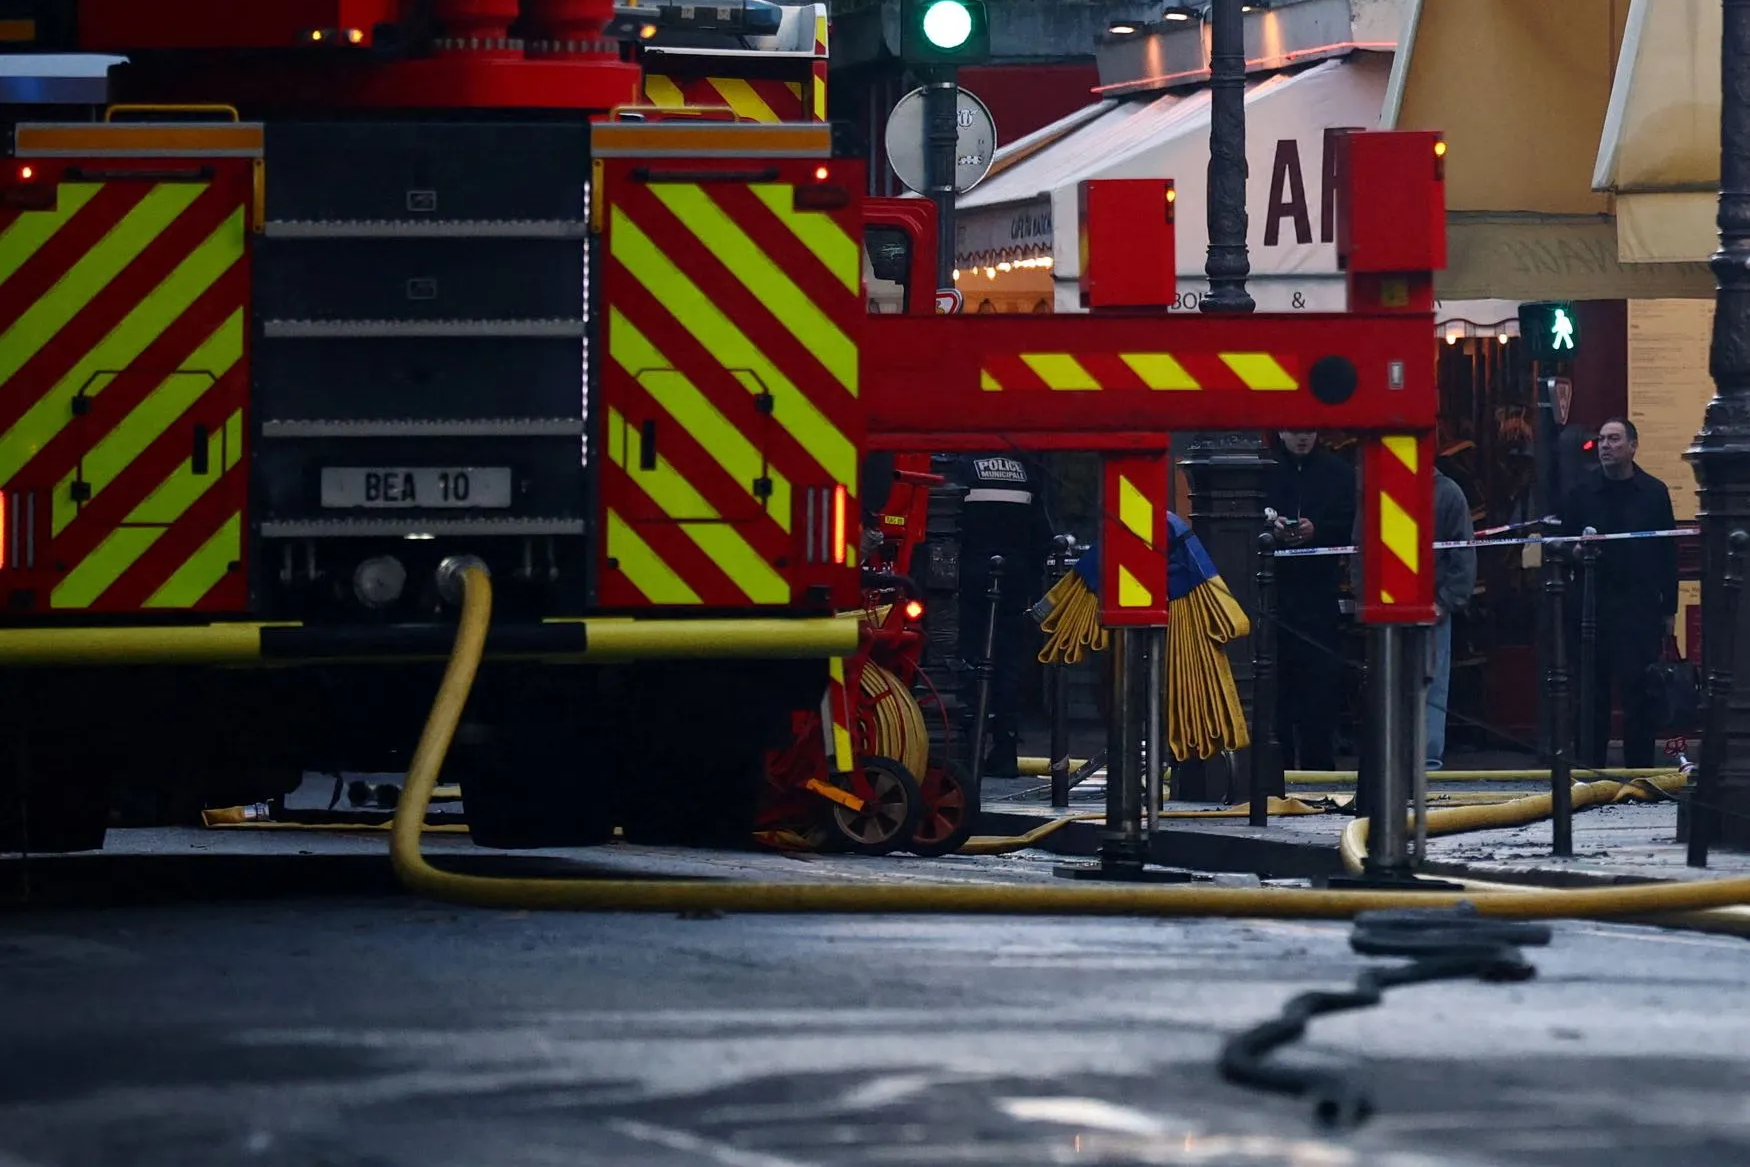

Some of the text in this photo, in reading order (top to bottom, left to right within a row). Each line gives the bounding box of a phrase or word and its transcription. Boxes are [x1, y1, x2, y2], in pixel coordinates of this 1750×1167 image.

[978, 459, 1024, 472] POLICE
[981, 471, 1025, 480] MUNICIPALE
[365, 471, 470, 503] BEA 10
